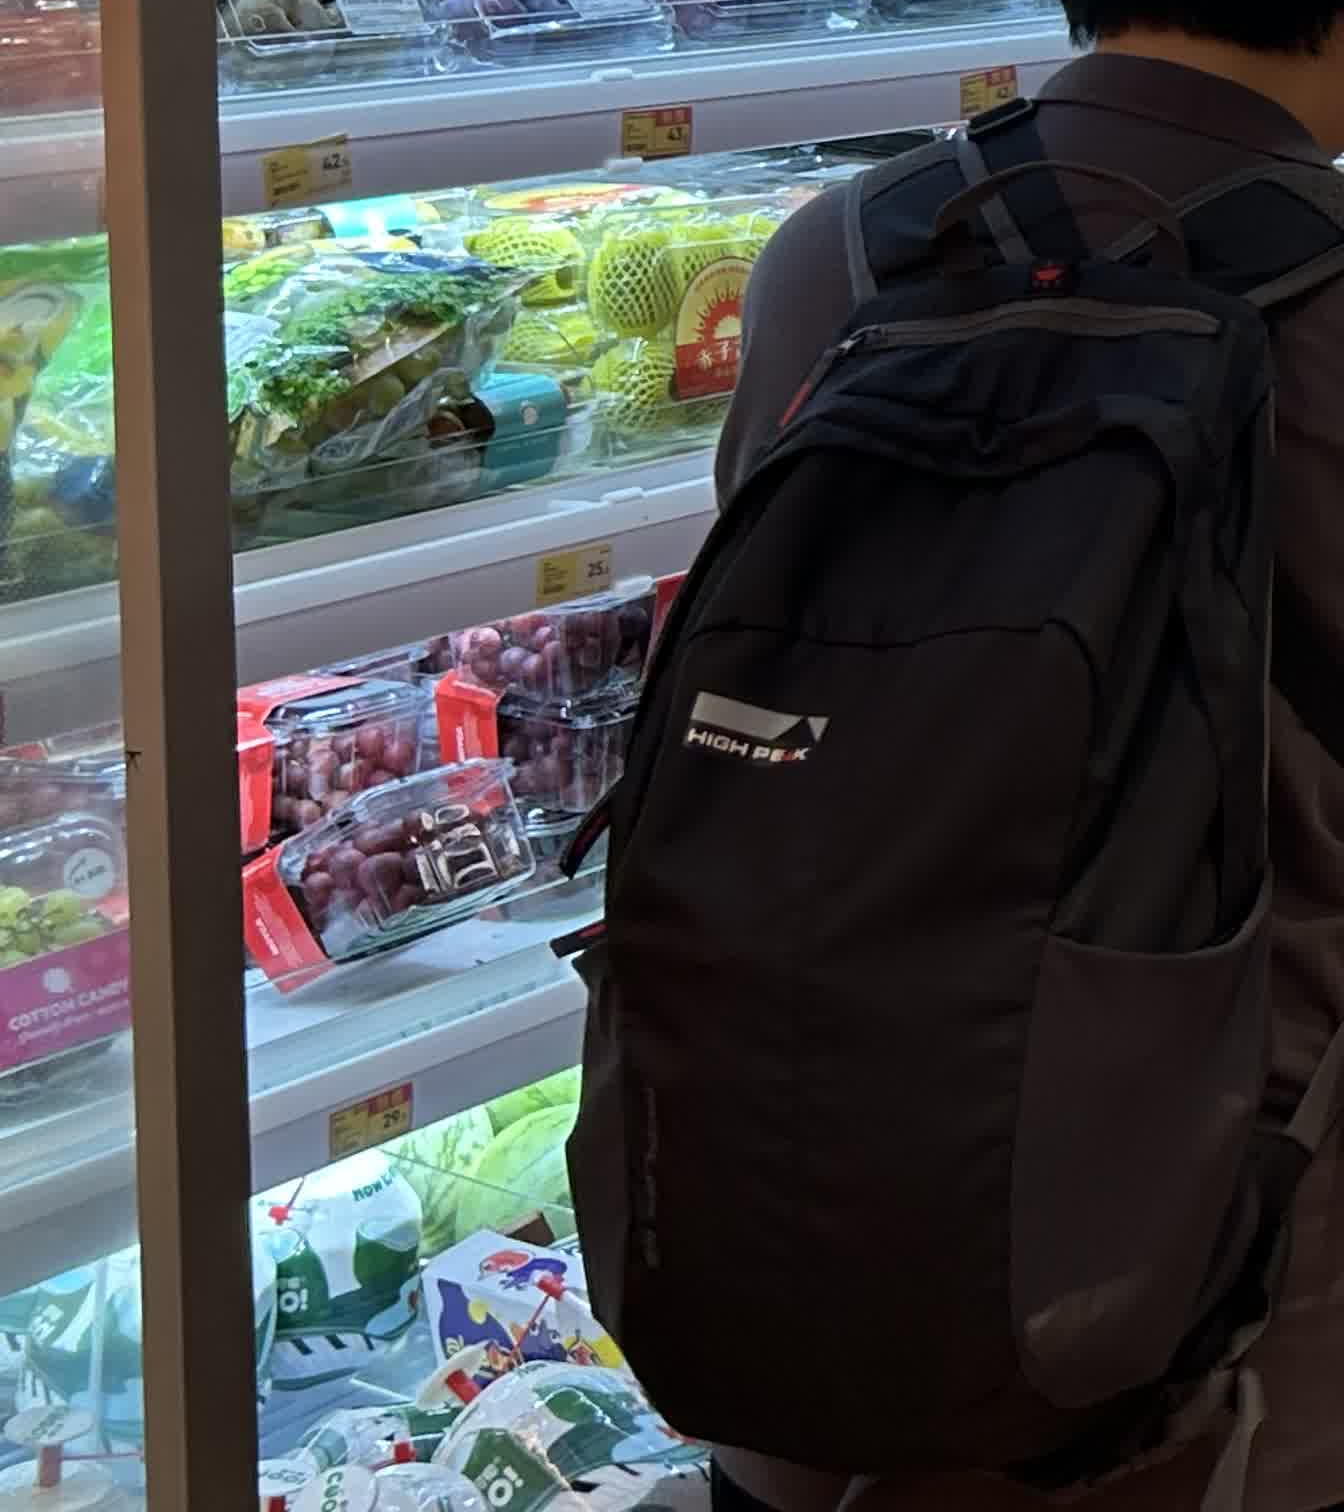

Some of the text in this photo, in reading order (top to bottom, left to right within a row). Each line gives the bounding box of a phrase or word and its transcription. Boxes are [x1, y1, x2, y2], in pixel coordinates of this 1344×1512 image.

[686, 727, 812, 763] HIGH PEAK
[7, 999, 75, 1032] COTTON
